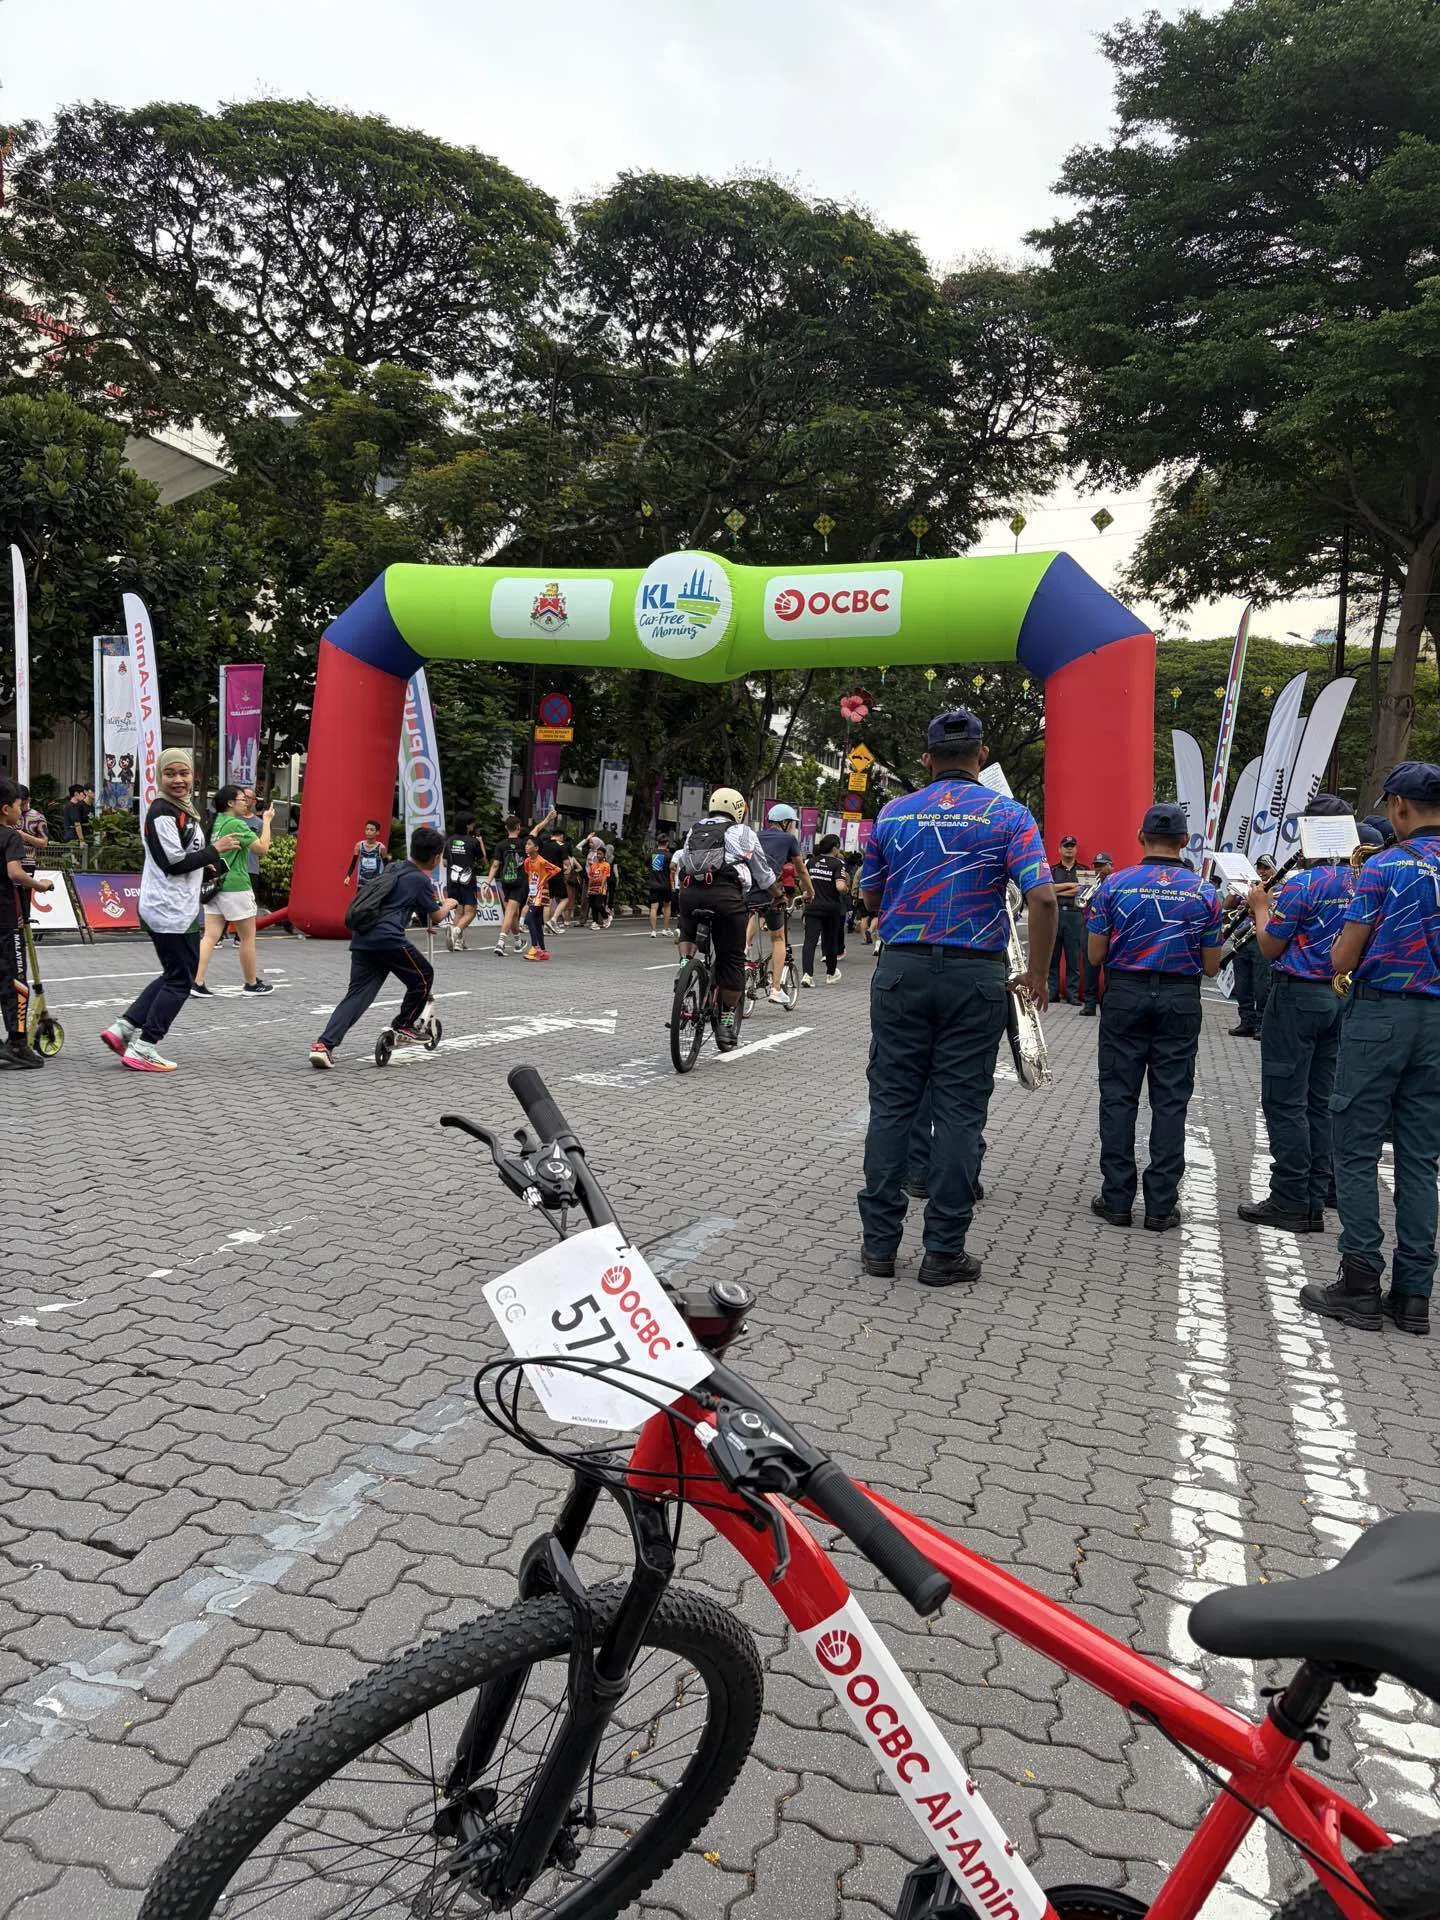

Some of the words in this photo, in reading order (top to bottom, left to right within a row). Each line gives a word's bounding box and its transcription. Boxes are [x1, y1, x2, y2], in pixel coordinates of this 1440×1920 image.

[642, 584, 675, 610] KL
[808, 588, 890, 615] OCBC
[639, 611, 685, 627] Car-Free
[652, 625, 698, 640] Morning
[898, 814, 914, 822] ONE
[962, 814, 991, 825] SOUND
[551, 1294, 631, 1376] 577
[619, 1290, 671, 1360] OCBC
[846, 1674, 930, 1785] OCBC
